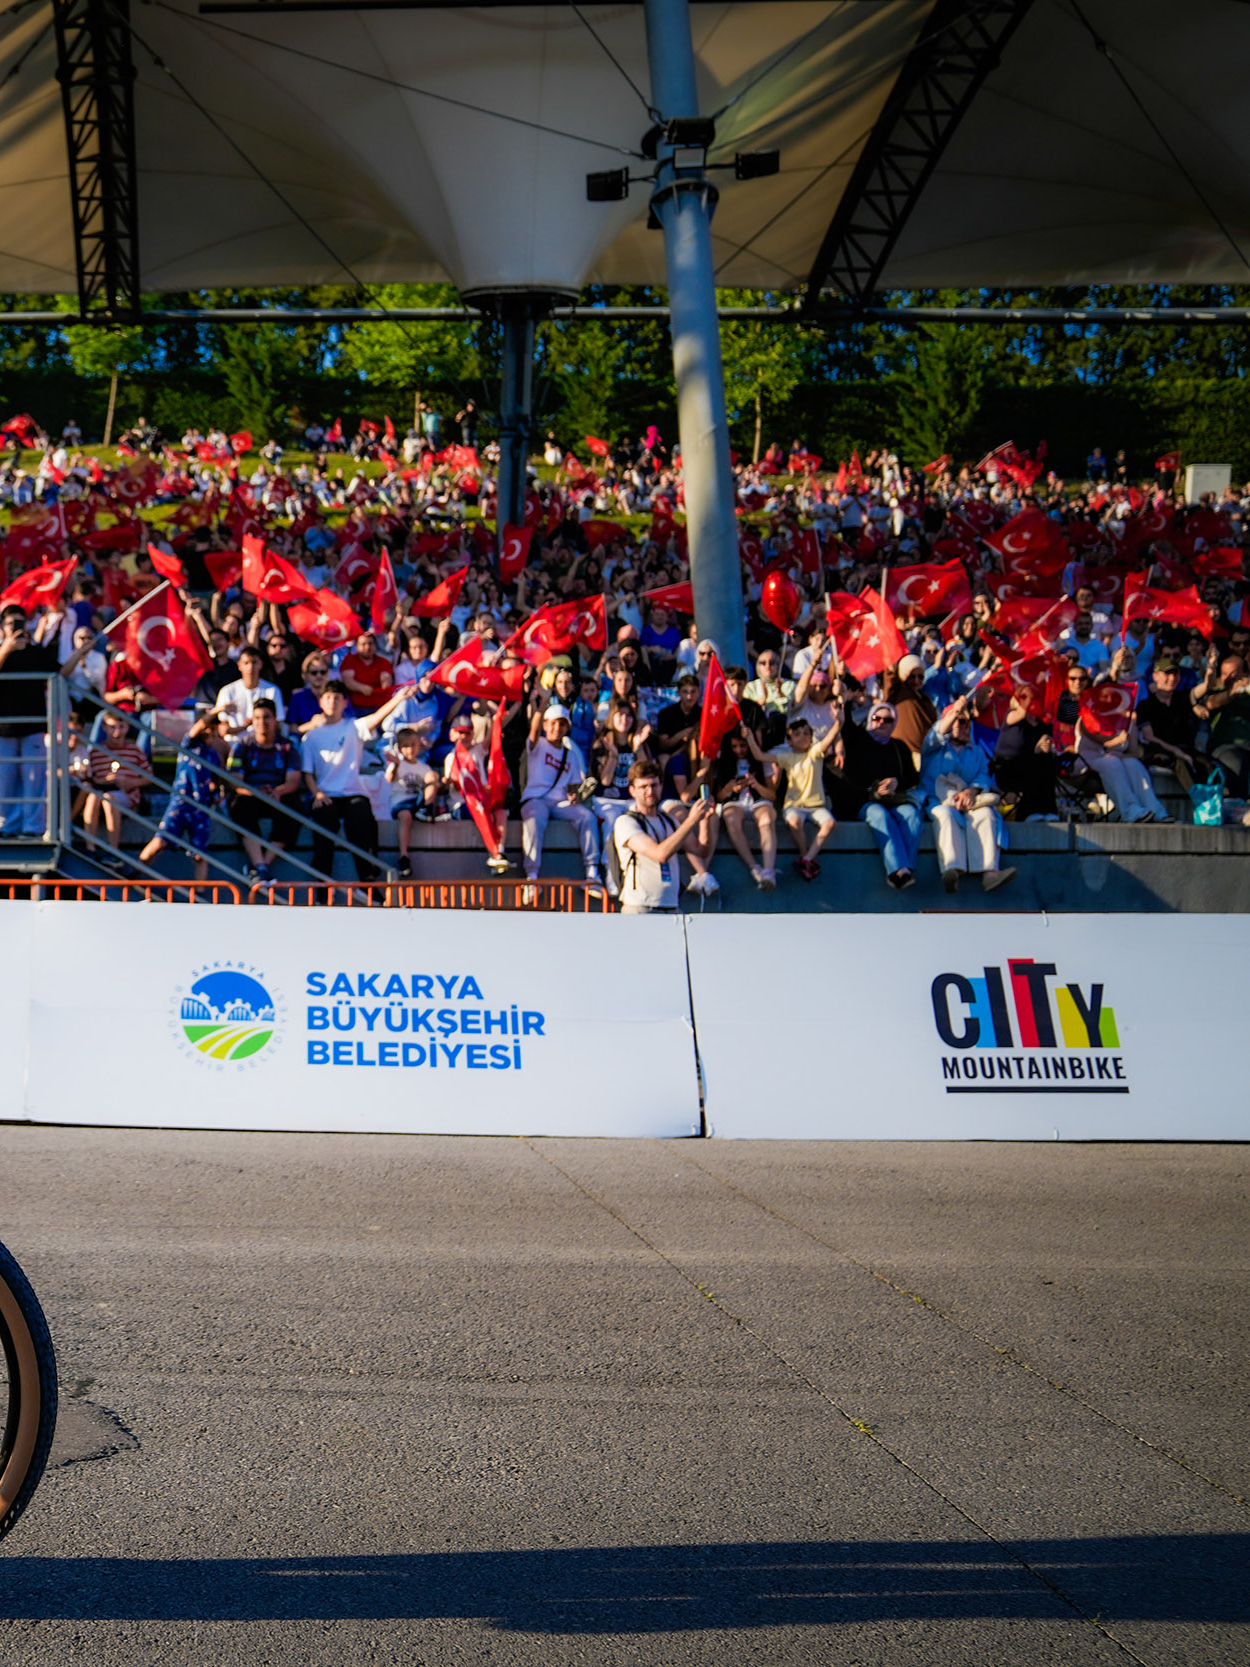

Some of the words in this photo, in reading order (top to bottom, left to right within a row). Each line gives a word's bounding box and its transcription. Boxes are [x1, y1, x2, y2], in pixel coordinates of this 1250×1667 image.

[306, 972, 484, 999] SAKARYA
[307, 1000, 546, 1038] BÜYÜKŞEHİR
[931, 959, 1114, 1049] CITY
[307, 1037, 522, 1070] BELEDİYESİ
[941, 1057, 1127, 1080] MOUNTAINBIKE
